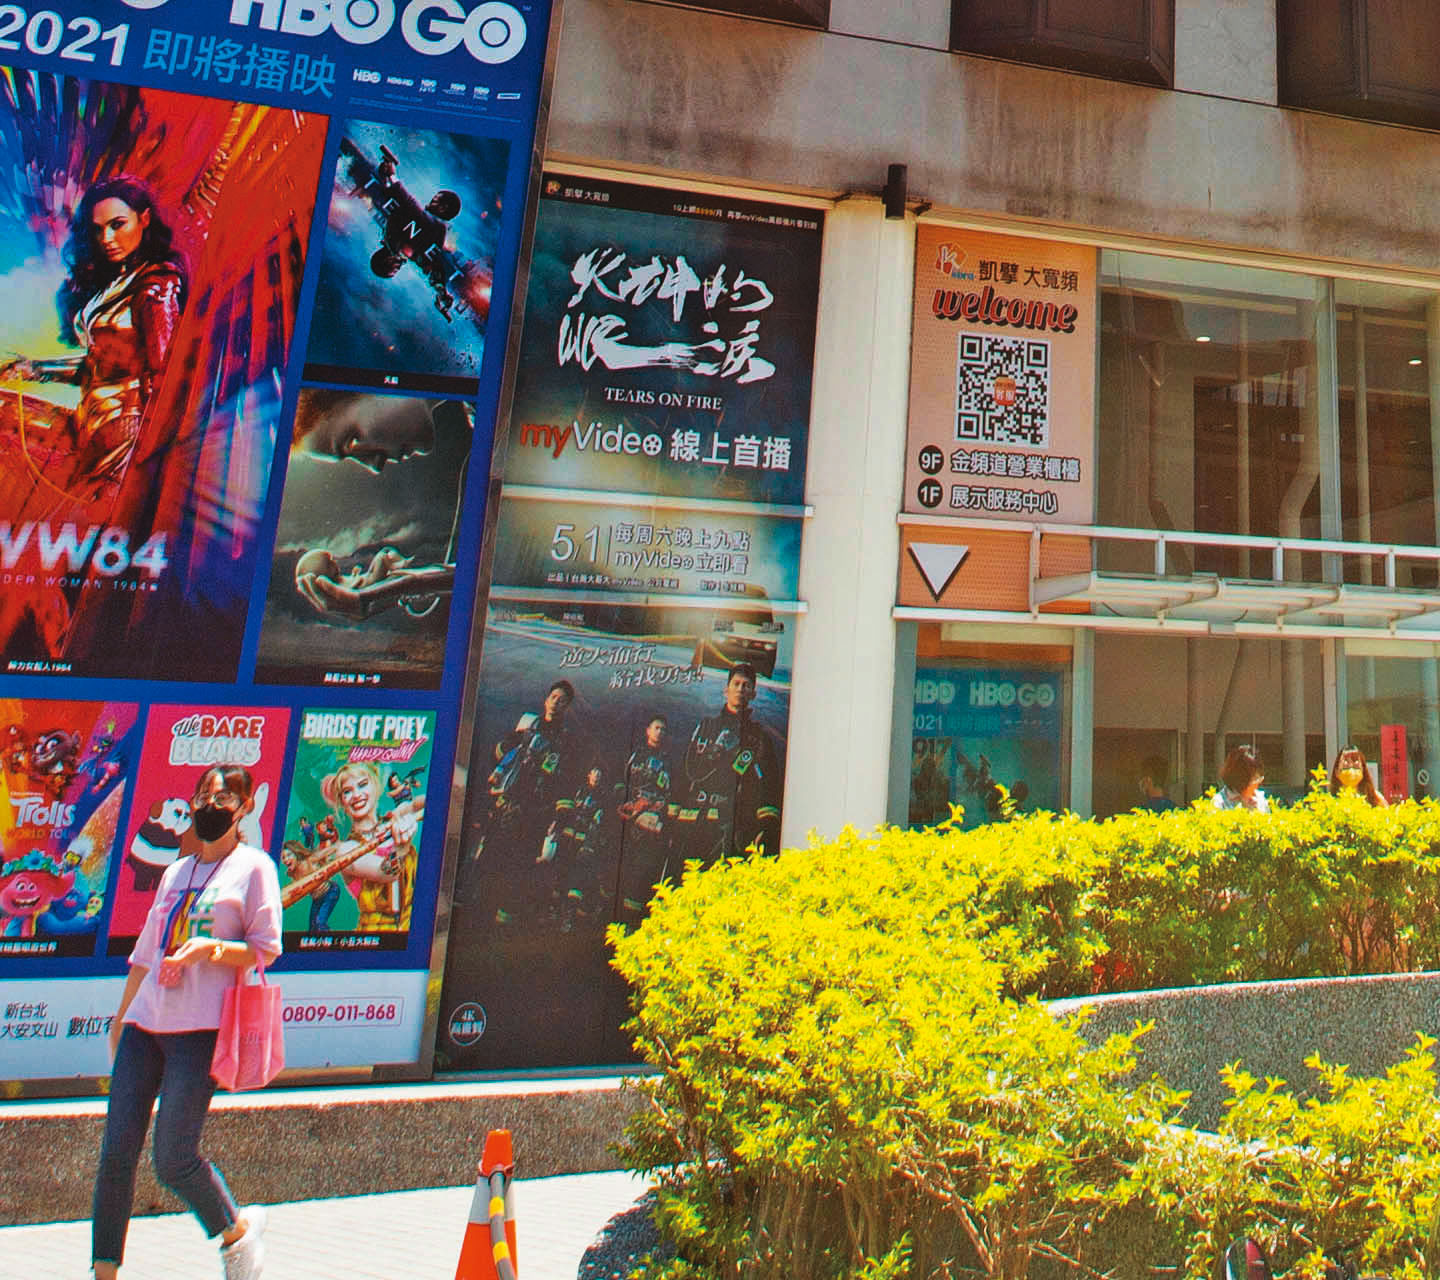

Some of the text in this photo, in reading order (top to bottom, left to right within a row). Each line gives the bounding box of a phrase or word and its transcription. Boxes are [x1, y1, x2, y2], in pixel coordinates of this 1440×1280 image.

[142, 28, 337, 100] 即將播映
[568, 248, 774, 322] 火神的
[979, 260, 1079, 291] 凱擘 大寬頻
[932, 286, 1078, 332] welcome
[604, 387, 723, 411] TEARS ON FIRE
[520, 421, 792, 470] myVideo 線上首播
[922, 454, 941, 470] 9F
[920, 485, 1058, 515] 1F 展示服務中心
[615, 550, 748, 575] myVideo 立即看
[45, 577, 103, 589] WOMAN
[969, 681, 1055, 707] HBO GO
[200, 716, 262, 739] BARE
[304, 713, 427, 739] BIRDS OF PREY
[912, 714, 943, 730] 021
[171, 739, 261, 765] BEARS
[4, 1001, 49, 1020] 新台北
[282, 1004, 396, 1023] 0809-011-868
[1, 1020, 59, 1038] 大安文山
